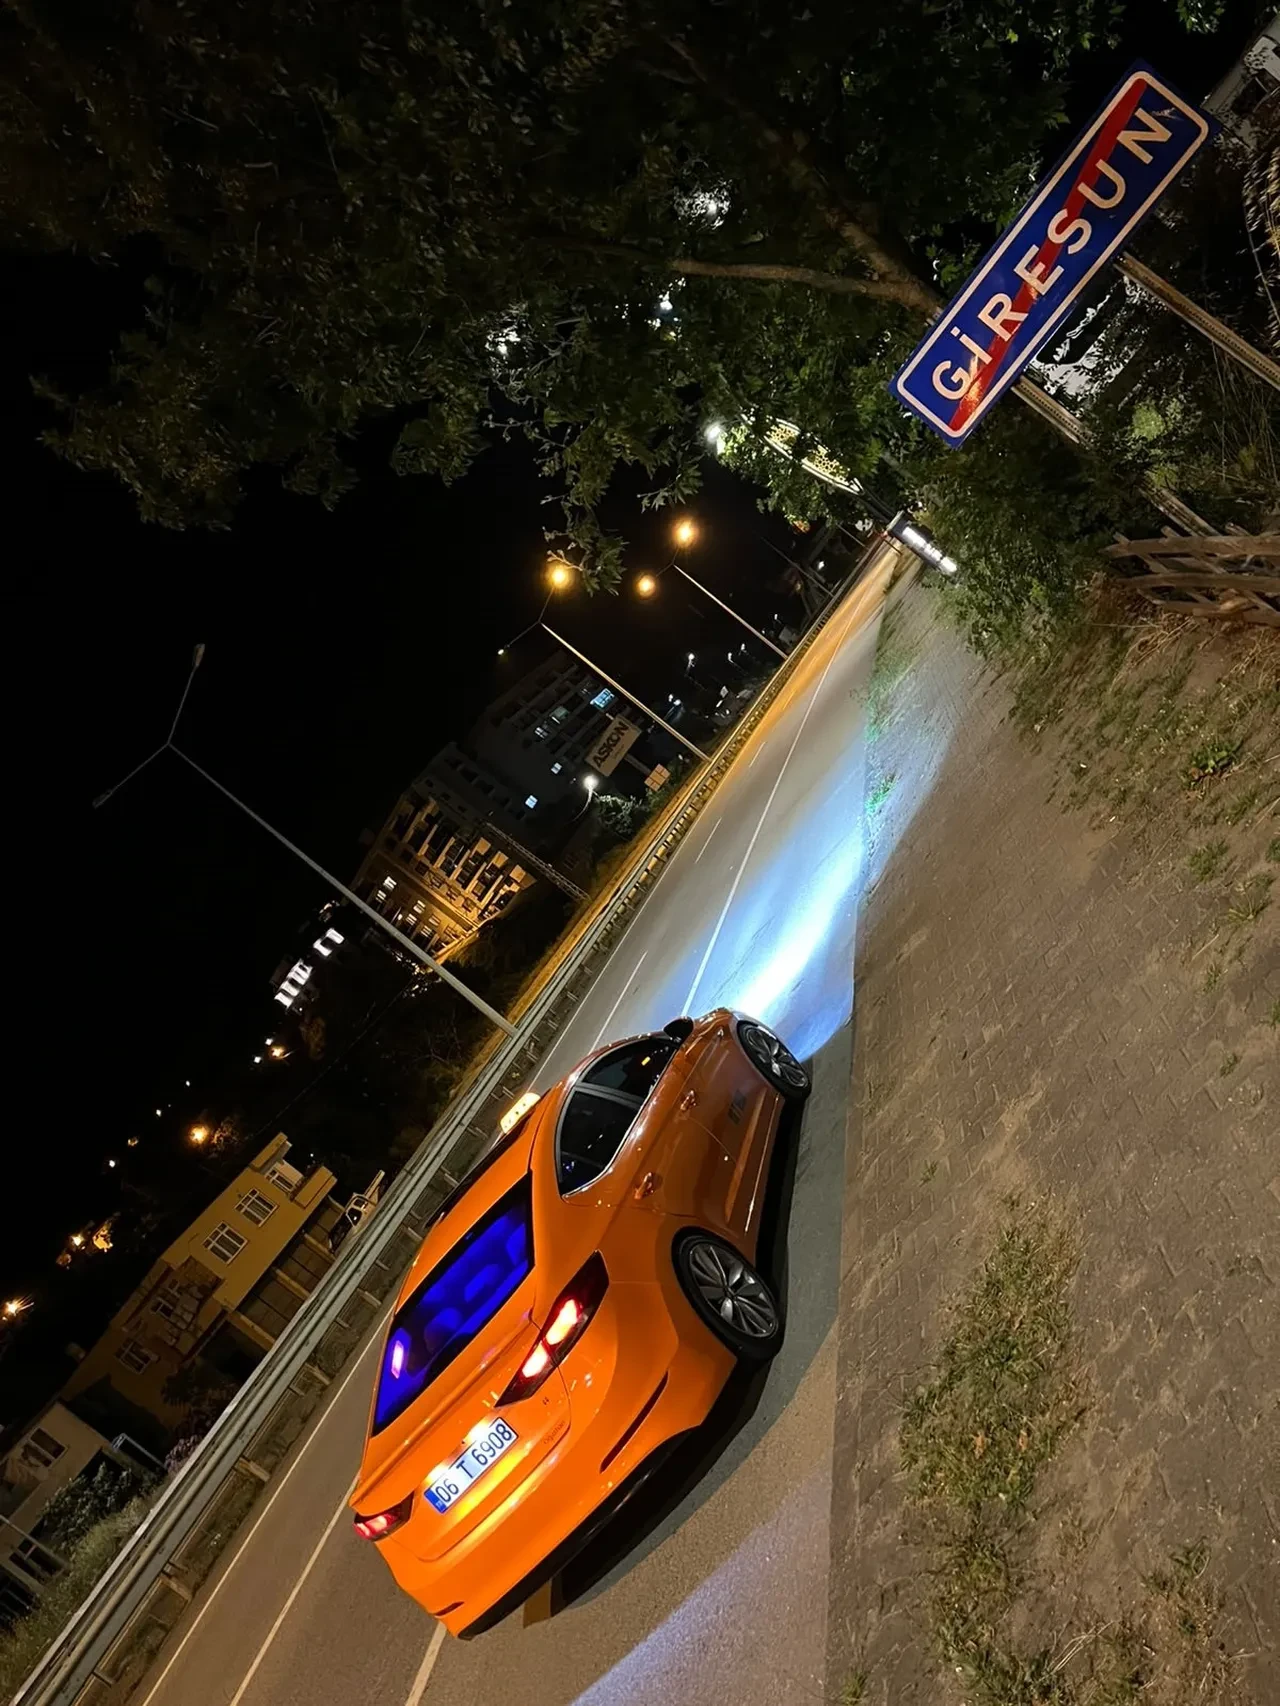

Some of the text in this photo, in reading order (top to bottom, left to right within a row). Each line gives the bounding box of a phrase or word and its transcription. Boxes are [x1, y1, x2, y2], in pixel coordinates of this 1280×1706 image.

[931, 107, 1173, 401] GİRESUN
[593, 721, 629, 767] ASKON
[435, 1478, 459, 1503] 06
[456, 1460, 473, 1479] T
[471, 1423, 512, 1466] 6908
